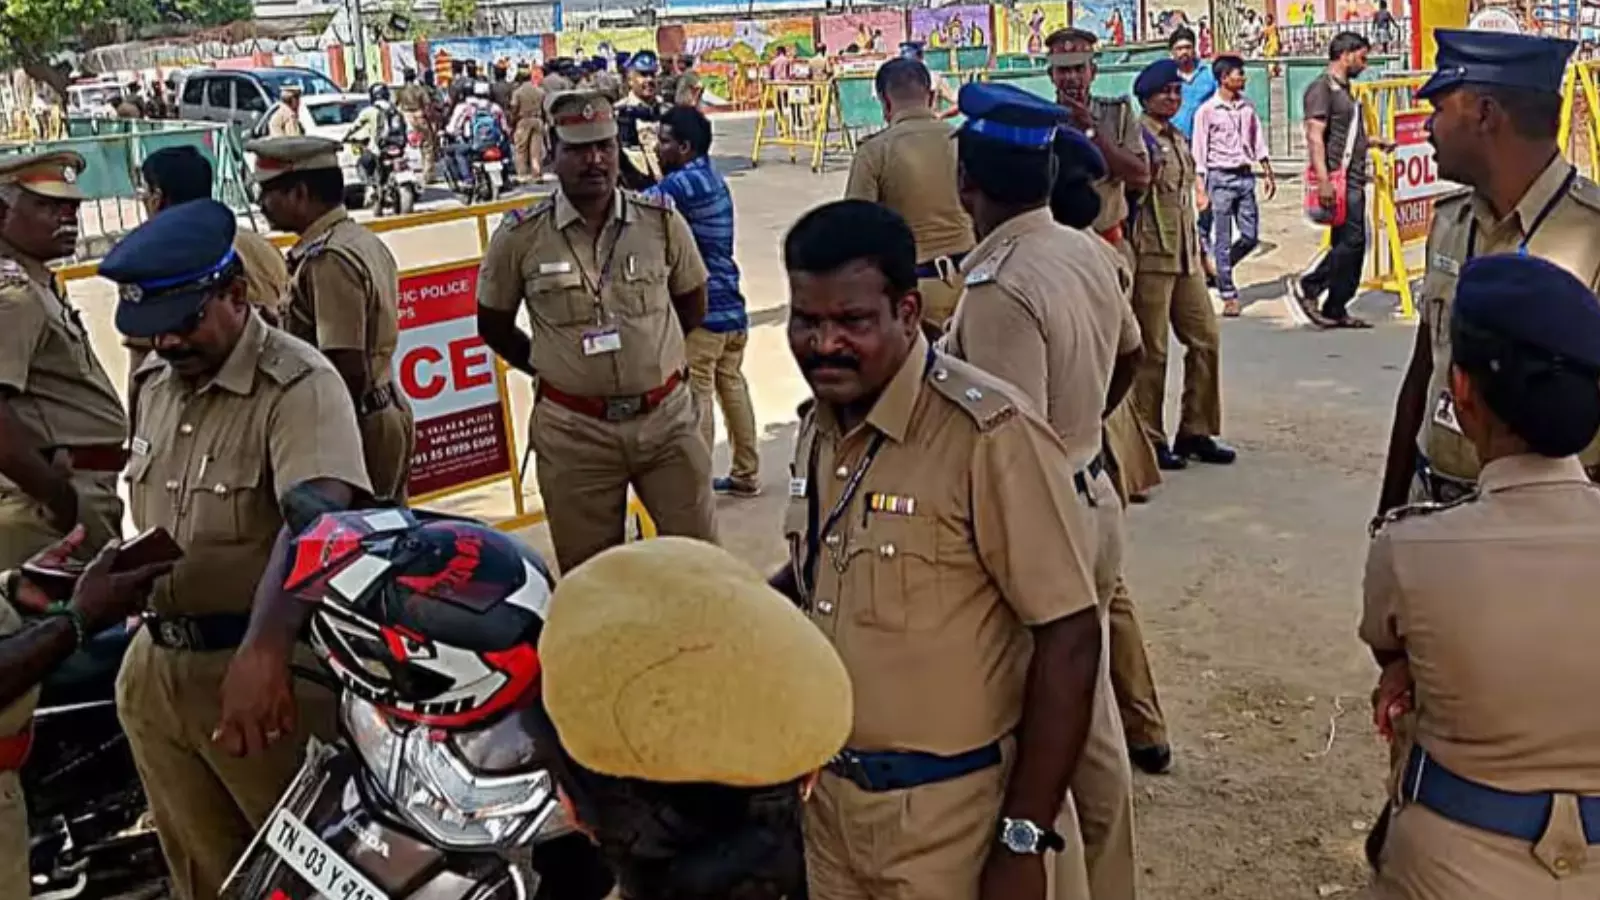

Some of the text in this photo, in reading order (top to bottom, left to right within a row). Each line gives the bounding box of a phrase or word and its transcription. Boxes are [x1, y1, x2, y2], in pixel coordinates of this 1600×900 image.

[420, 278, 471, 301] POLICE
[399, 336, 493, 400] CE
[277, 819, 300, 852] TN
[304, 847, 327, 877] 03
[327, 865, 344, 890] Y
